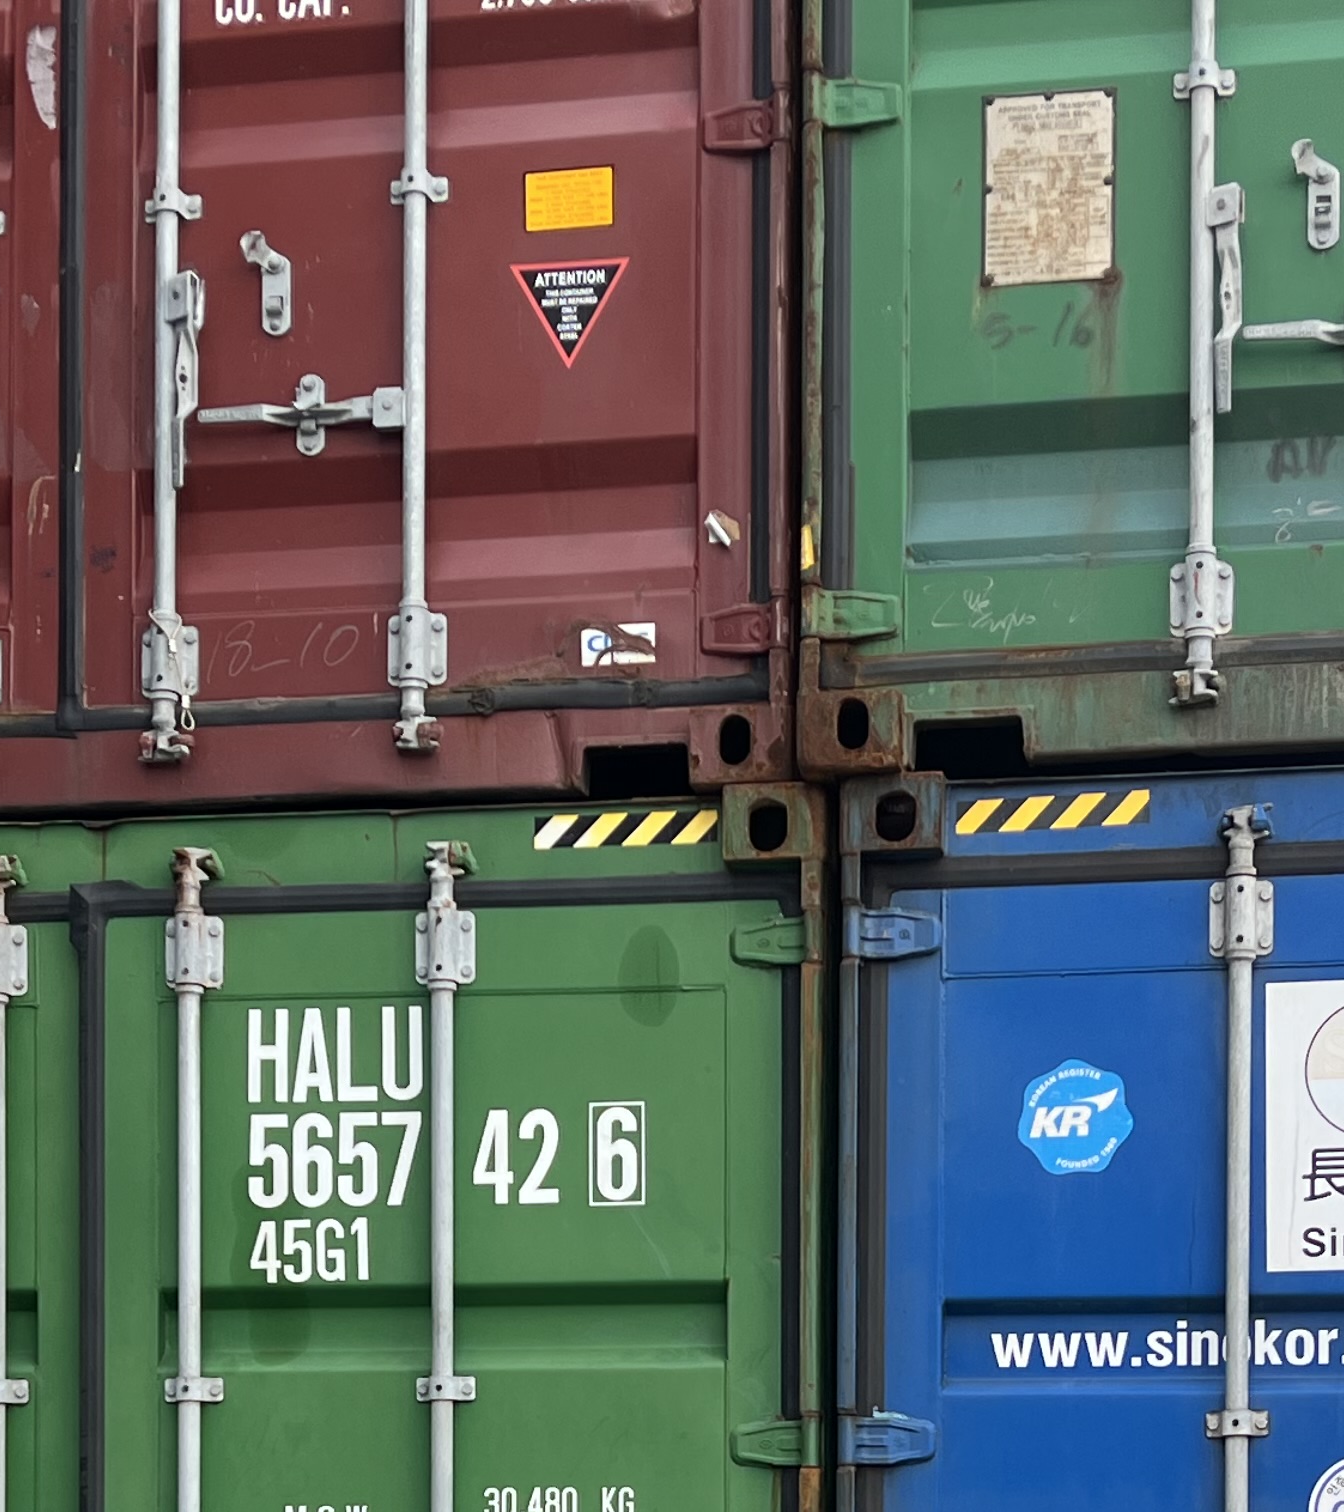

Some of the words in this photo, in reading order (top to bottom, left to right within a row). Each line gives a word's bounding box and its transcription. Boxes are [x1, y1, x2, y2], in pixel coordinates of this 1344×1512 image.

[535, 269, 606, 287] ATTENTION
[247, 1005, 422, 1103] HALU
[1058, 1068, 1101, 1080] REGISTER
[1029, 1105, 1092, 1138] KR
[247, 1111, 422, 1209] 5657
[473, 1107, 559, 1205] 42
[595, 1105, 640, 1203] 6
[250, 1217, 370, 1284] 45G1
